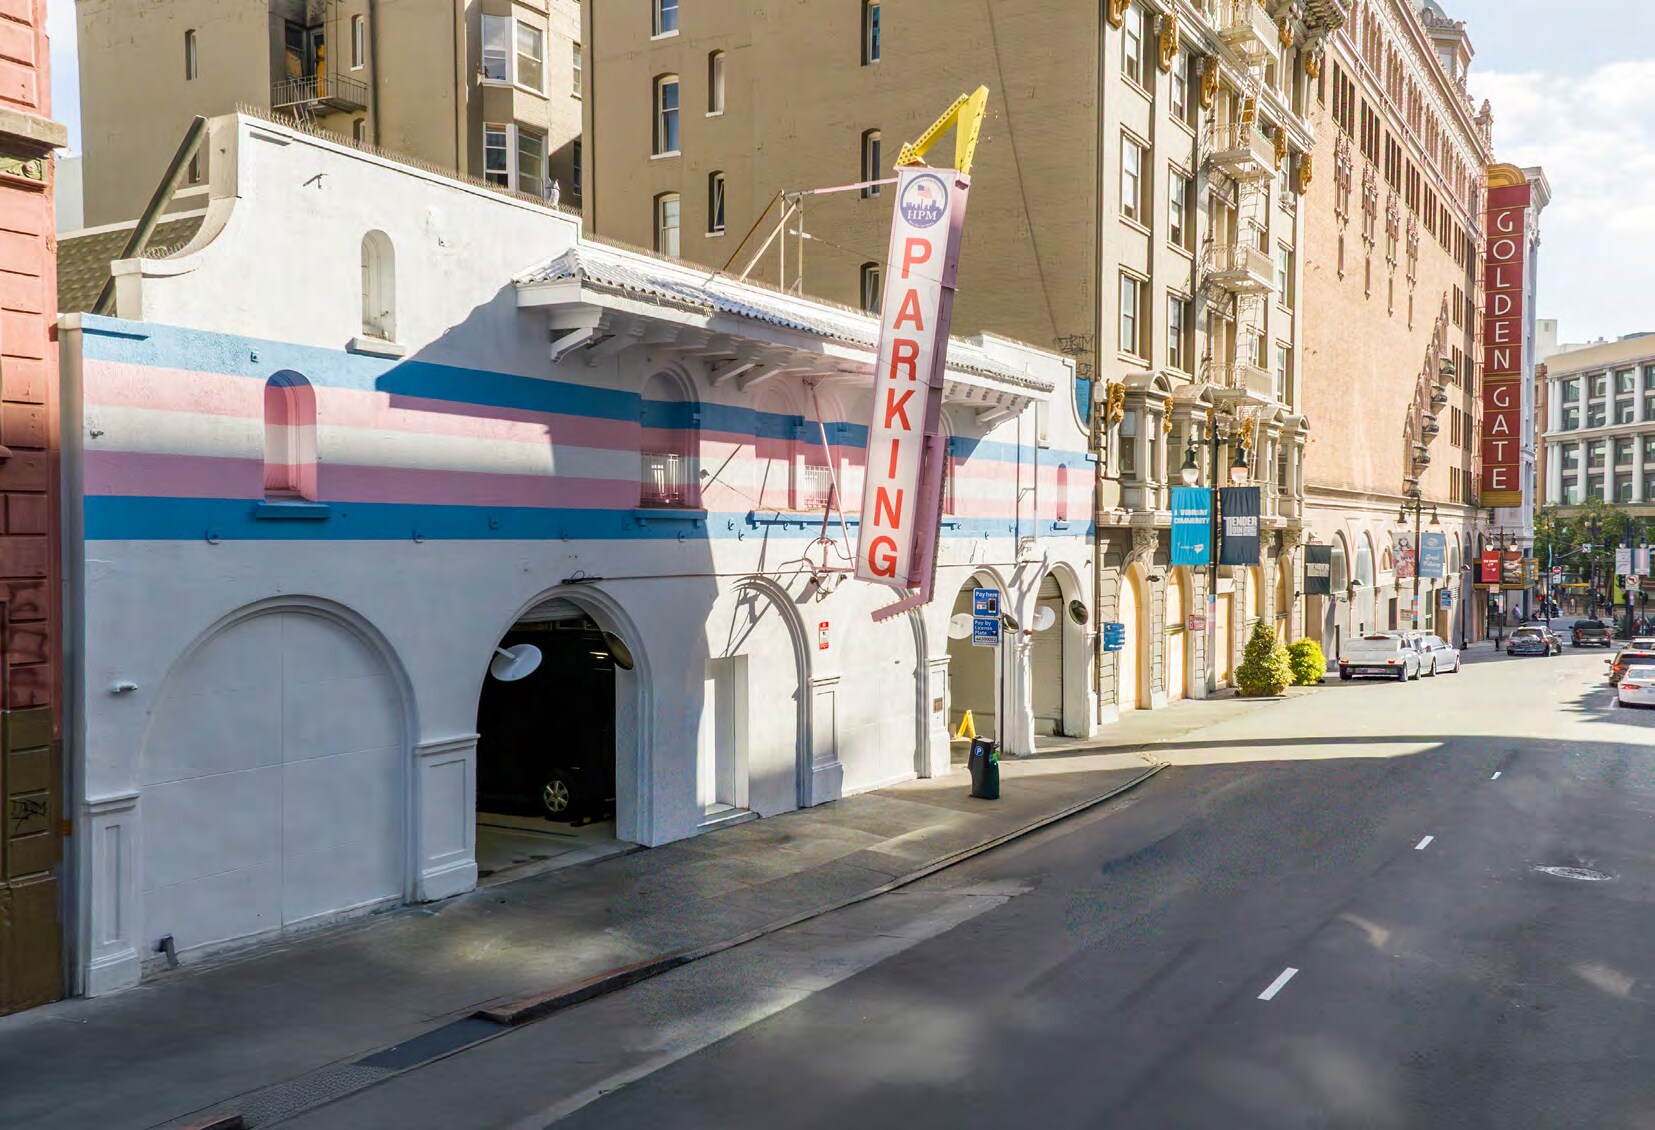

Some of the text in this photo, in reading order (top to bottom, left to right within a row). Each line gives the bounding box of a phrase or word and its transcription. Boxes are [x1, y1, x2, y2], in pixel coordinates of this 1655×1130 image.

[907, 210, 937, 220] HPM
[867, 237, 933, 579] PARKING
[1492, 211, 1516, 489] GOLDEN GATE
[975, 591, 985, 599] Pay
